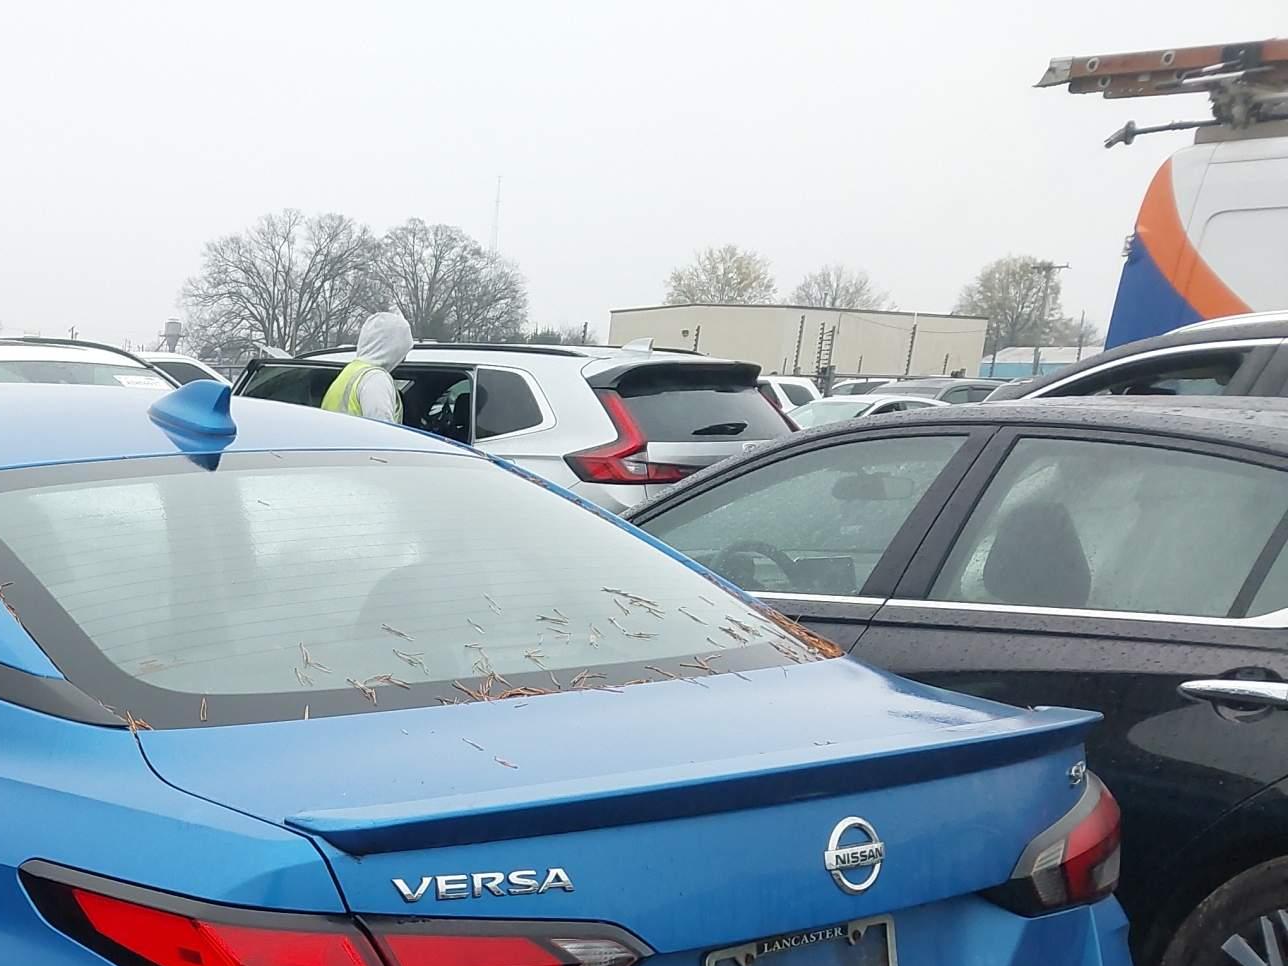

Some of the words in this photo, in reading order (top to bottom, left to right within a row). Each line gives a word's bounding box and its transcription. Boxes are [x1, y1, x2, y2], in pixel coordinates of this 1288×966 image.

[835, 846, 883, 865] NISSAN
[392, 867, 575, 903] VERSA
[763, 926, 843, 953] LANCASTER
